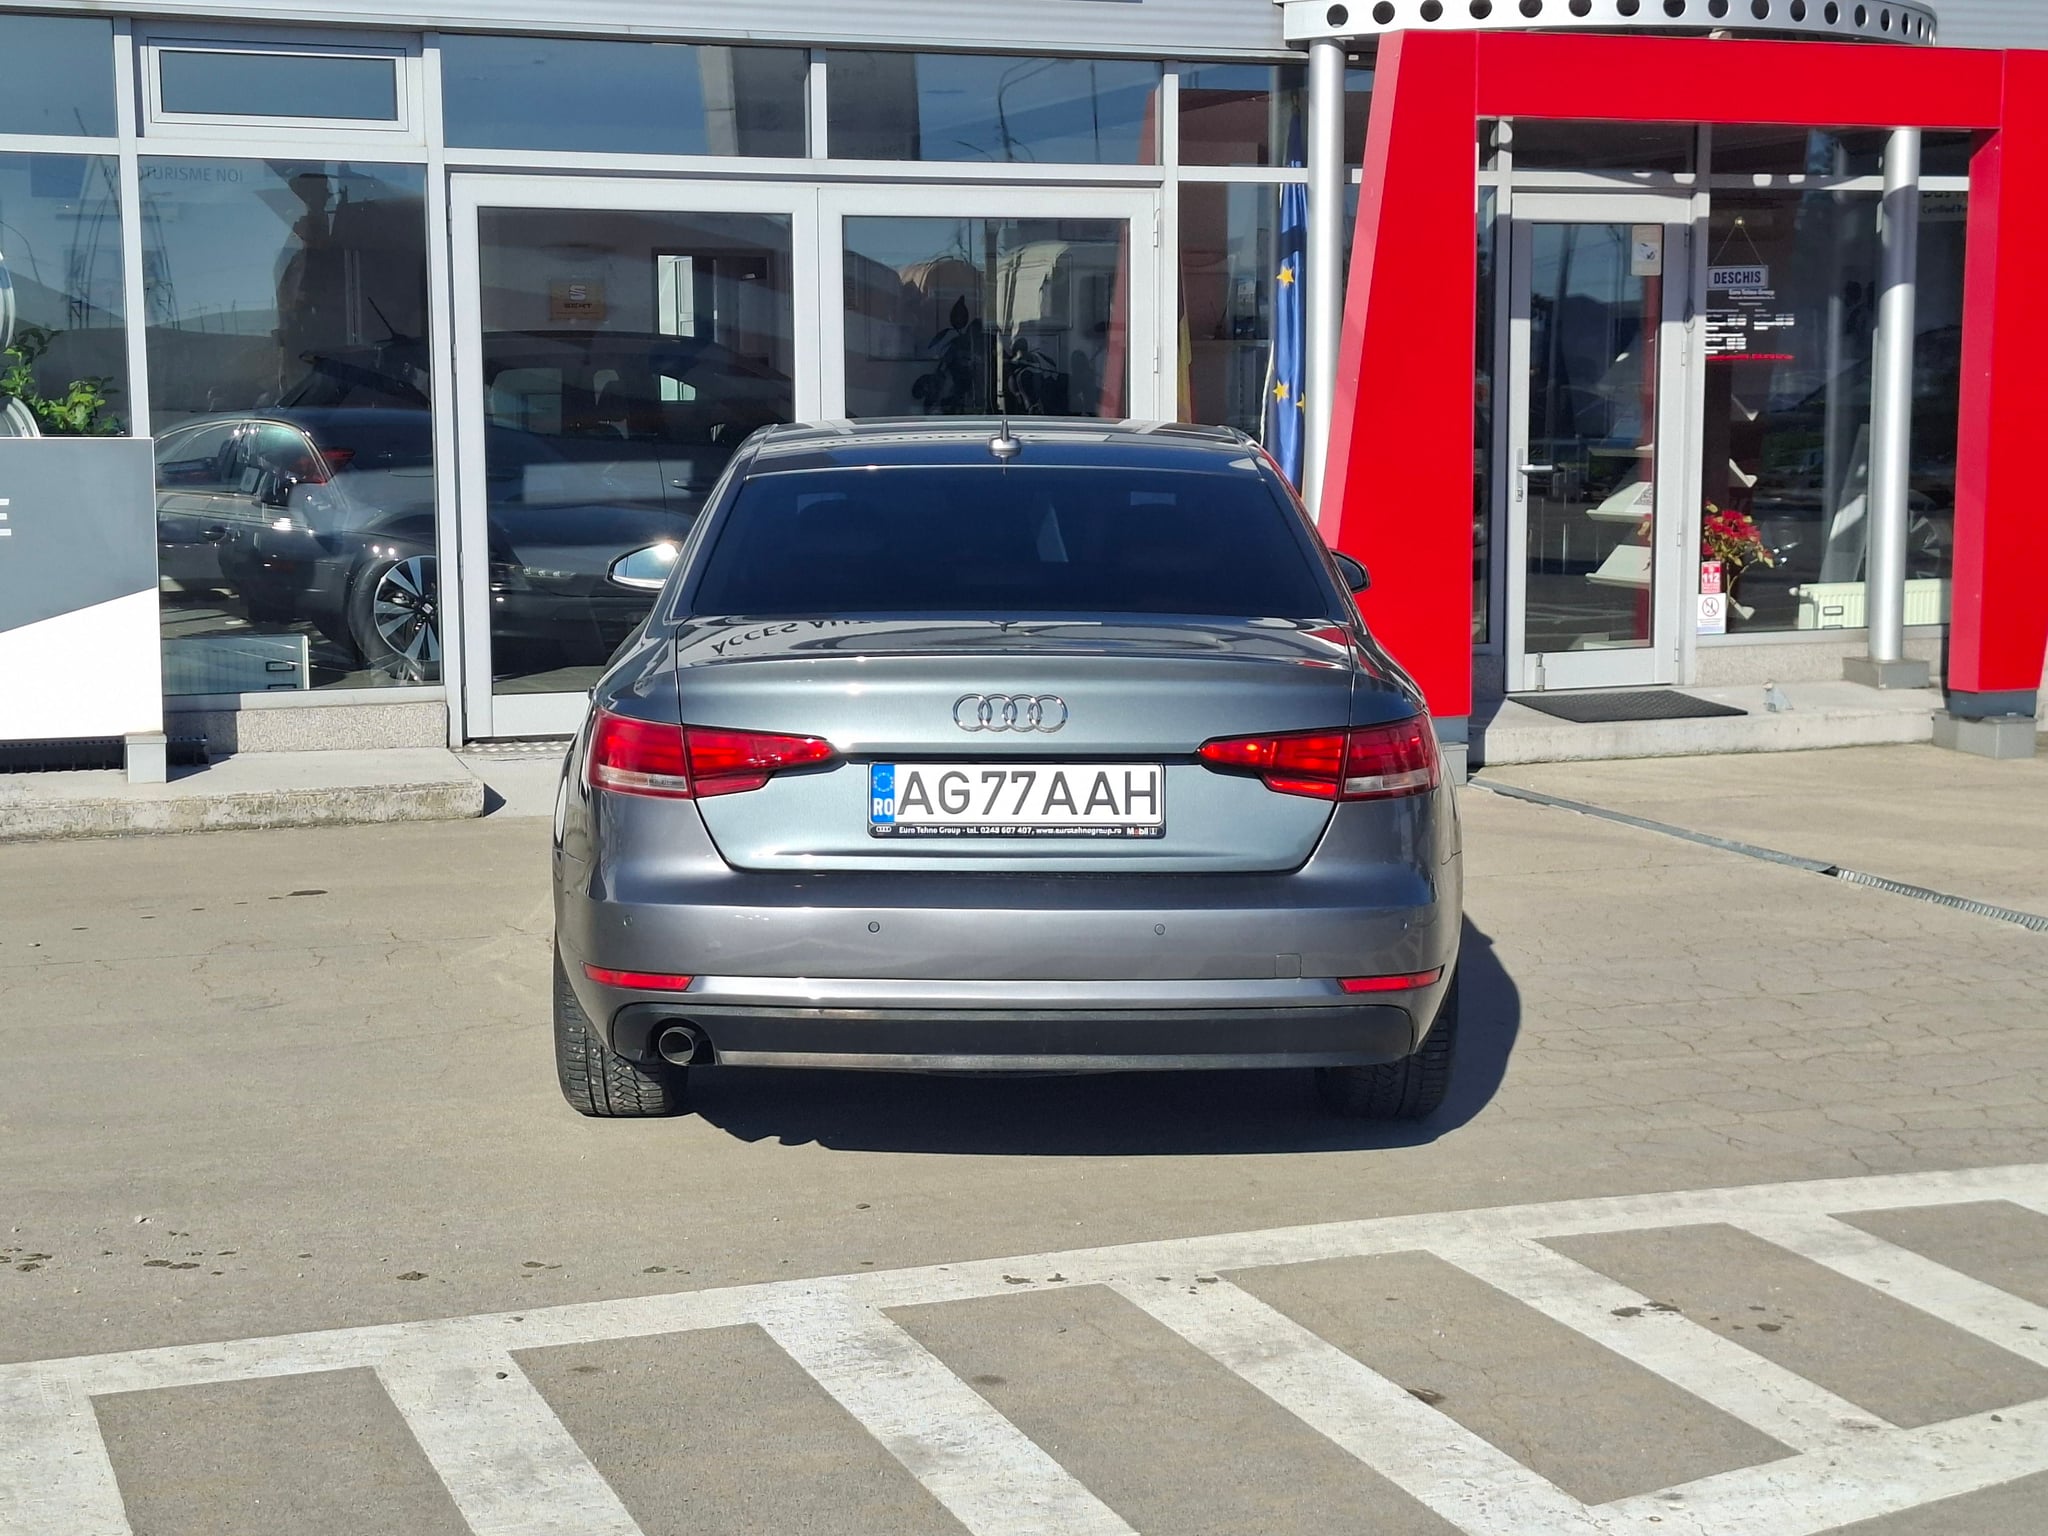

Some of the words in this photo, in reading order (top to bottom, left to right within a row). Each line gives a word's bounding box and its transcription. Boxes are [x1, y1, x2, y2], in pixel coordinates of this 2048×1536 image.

[216, 168, 243, 184] NOI
[1714, 271, 1761, 284] DESCHIS
[1703, 573, 1719, 583] 112
[873, 798, 894, 816] RO
[899, 826, 915, 834] Euro
[916, 826, 937, 834] Tehno
[939, 826, 961, 836] Group
[1127, 827, 1148, 835] Mobil
